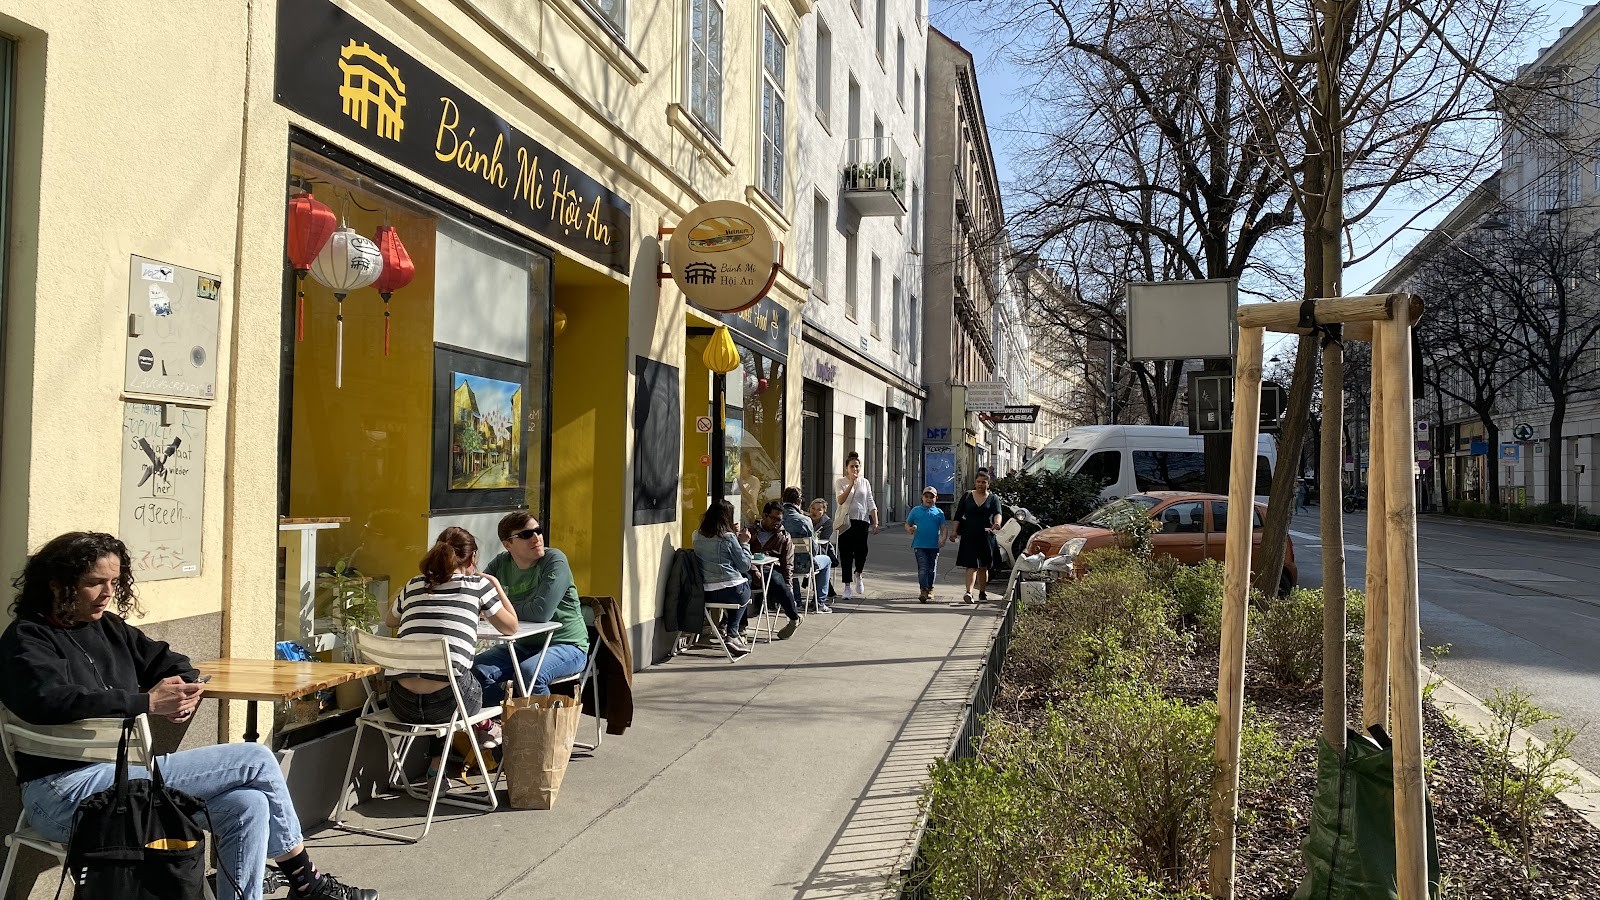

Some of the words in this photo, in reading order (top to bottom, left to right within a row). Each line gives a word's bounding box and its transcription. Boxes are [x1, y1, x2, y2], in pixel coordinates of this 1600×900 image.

[435, 96, 508, 189] Bánh
[513, 146, 545, 210] Mì
[550, 168, 583, 236] Hội
[586, 195, 611, 246] An
[740, 276, 754, 286] An
[156, 483, 171, 494] her
